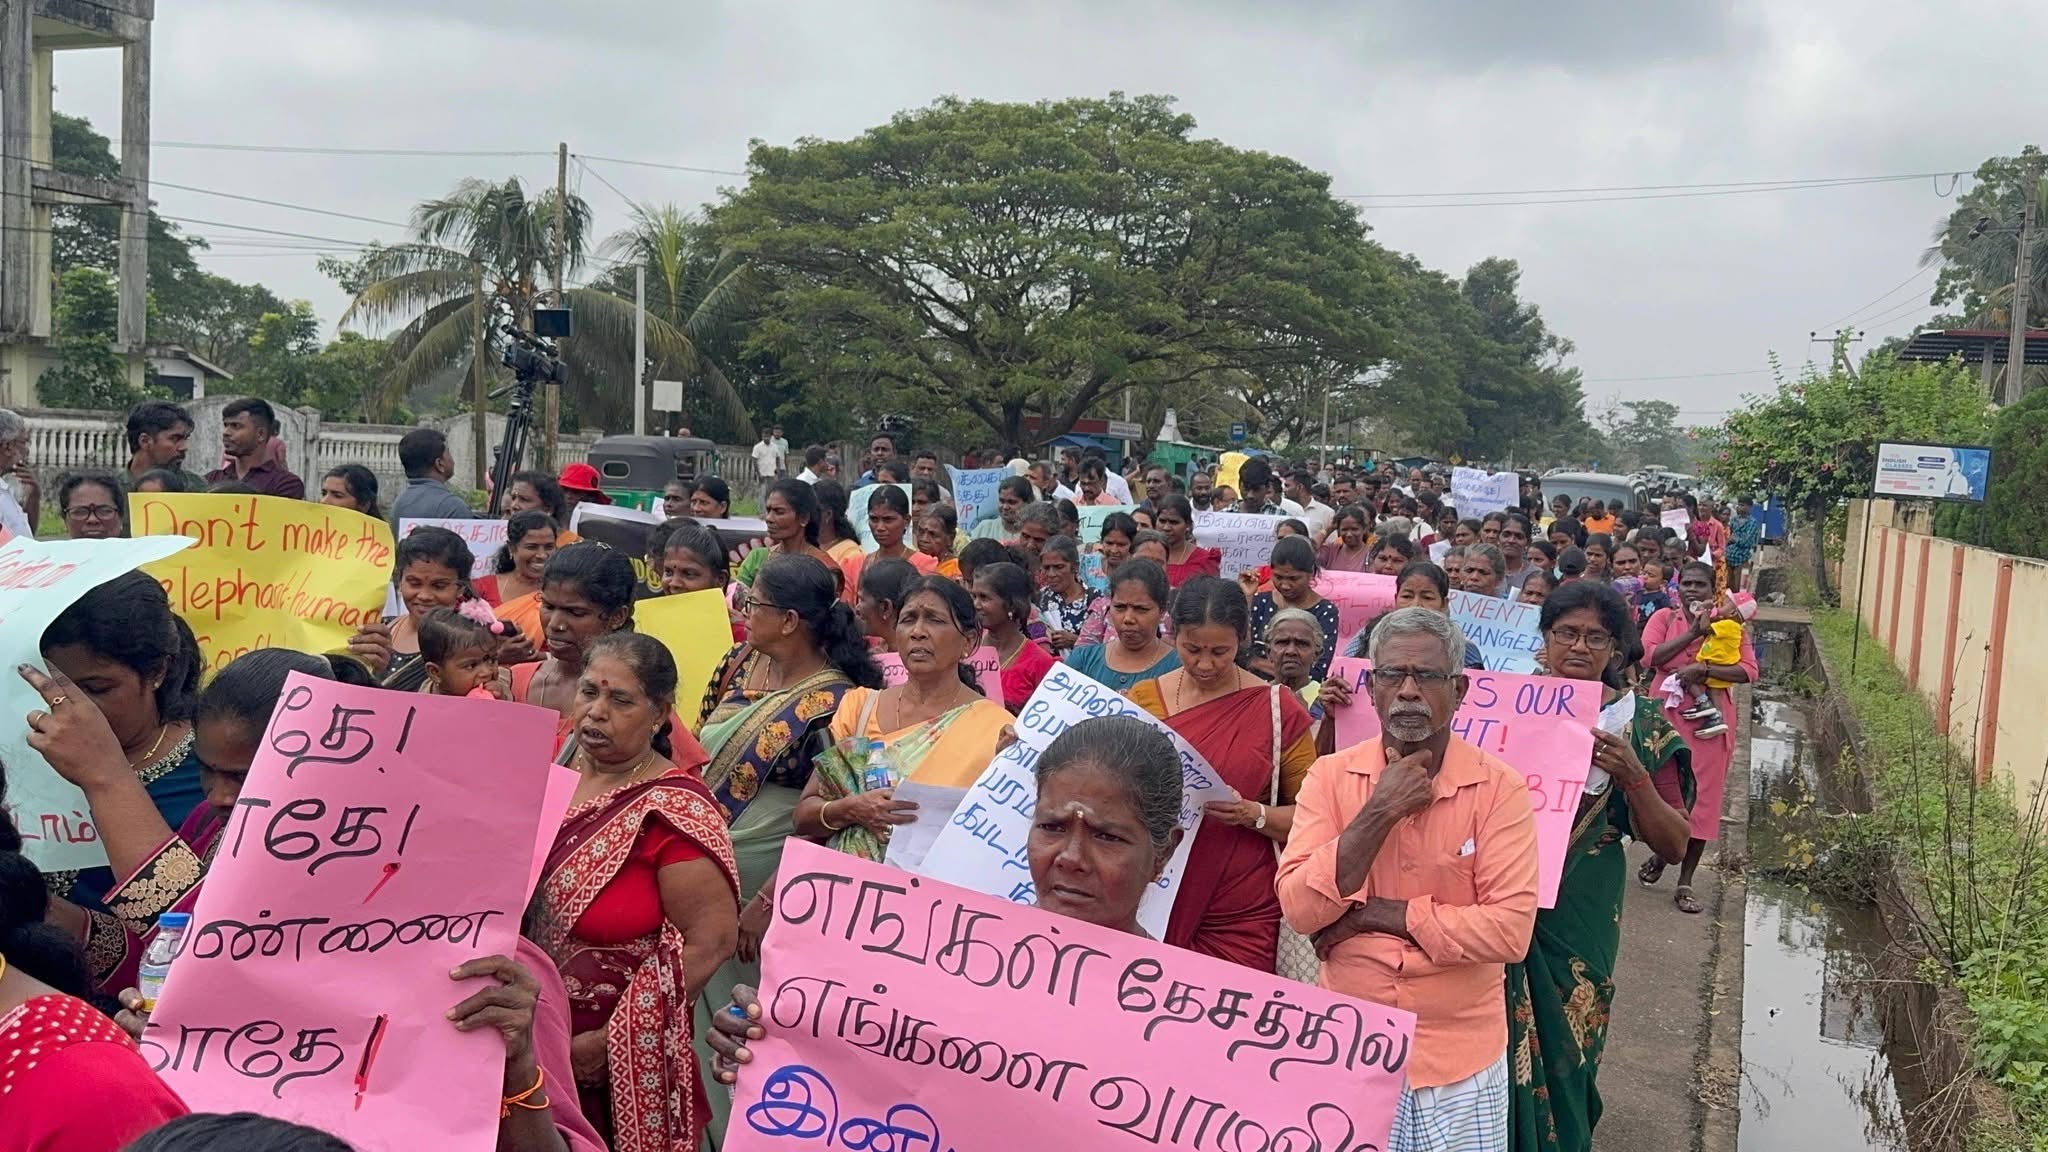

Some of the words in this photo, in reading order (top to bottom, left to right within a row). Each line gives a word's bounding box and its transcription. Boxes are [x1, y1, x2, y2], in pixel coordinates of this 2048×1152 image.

[143, 497, 266, 551] Don't
[282, 516, 349, 560] make
[356, 521, 391, 567] the
[1447, 591, 1535, 628] RMENT
[1456, 621, 1546, 653] HANGED
[1515, 684, 1577, 718] OUR
[1451, 717, 1508, 753] HT!
[780, 870, 1111, 1006] எங்கள்
[1117, 956, 1410, 1083] தேசத்தில்
[770, 974, 1089, 1103] எங்களை
